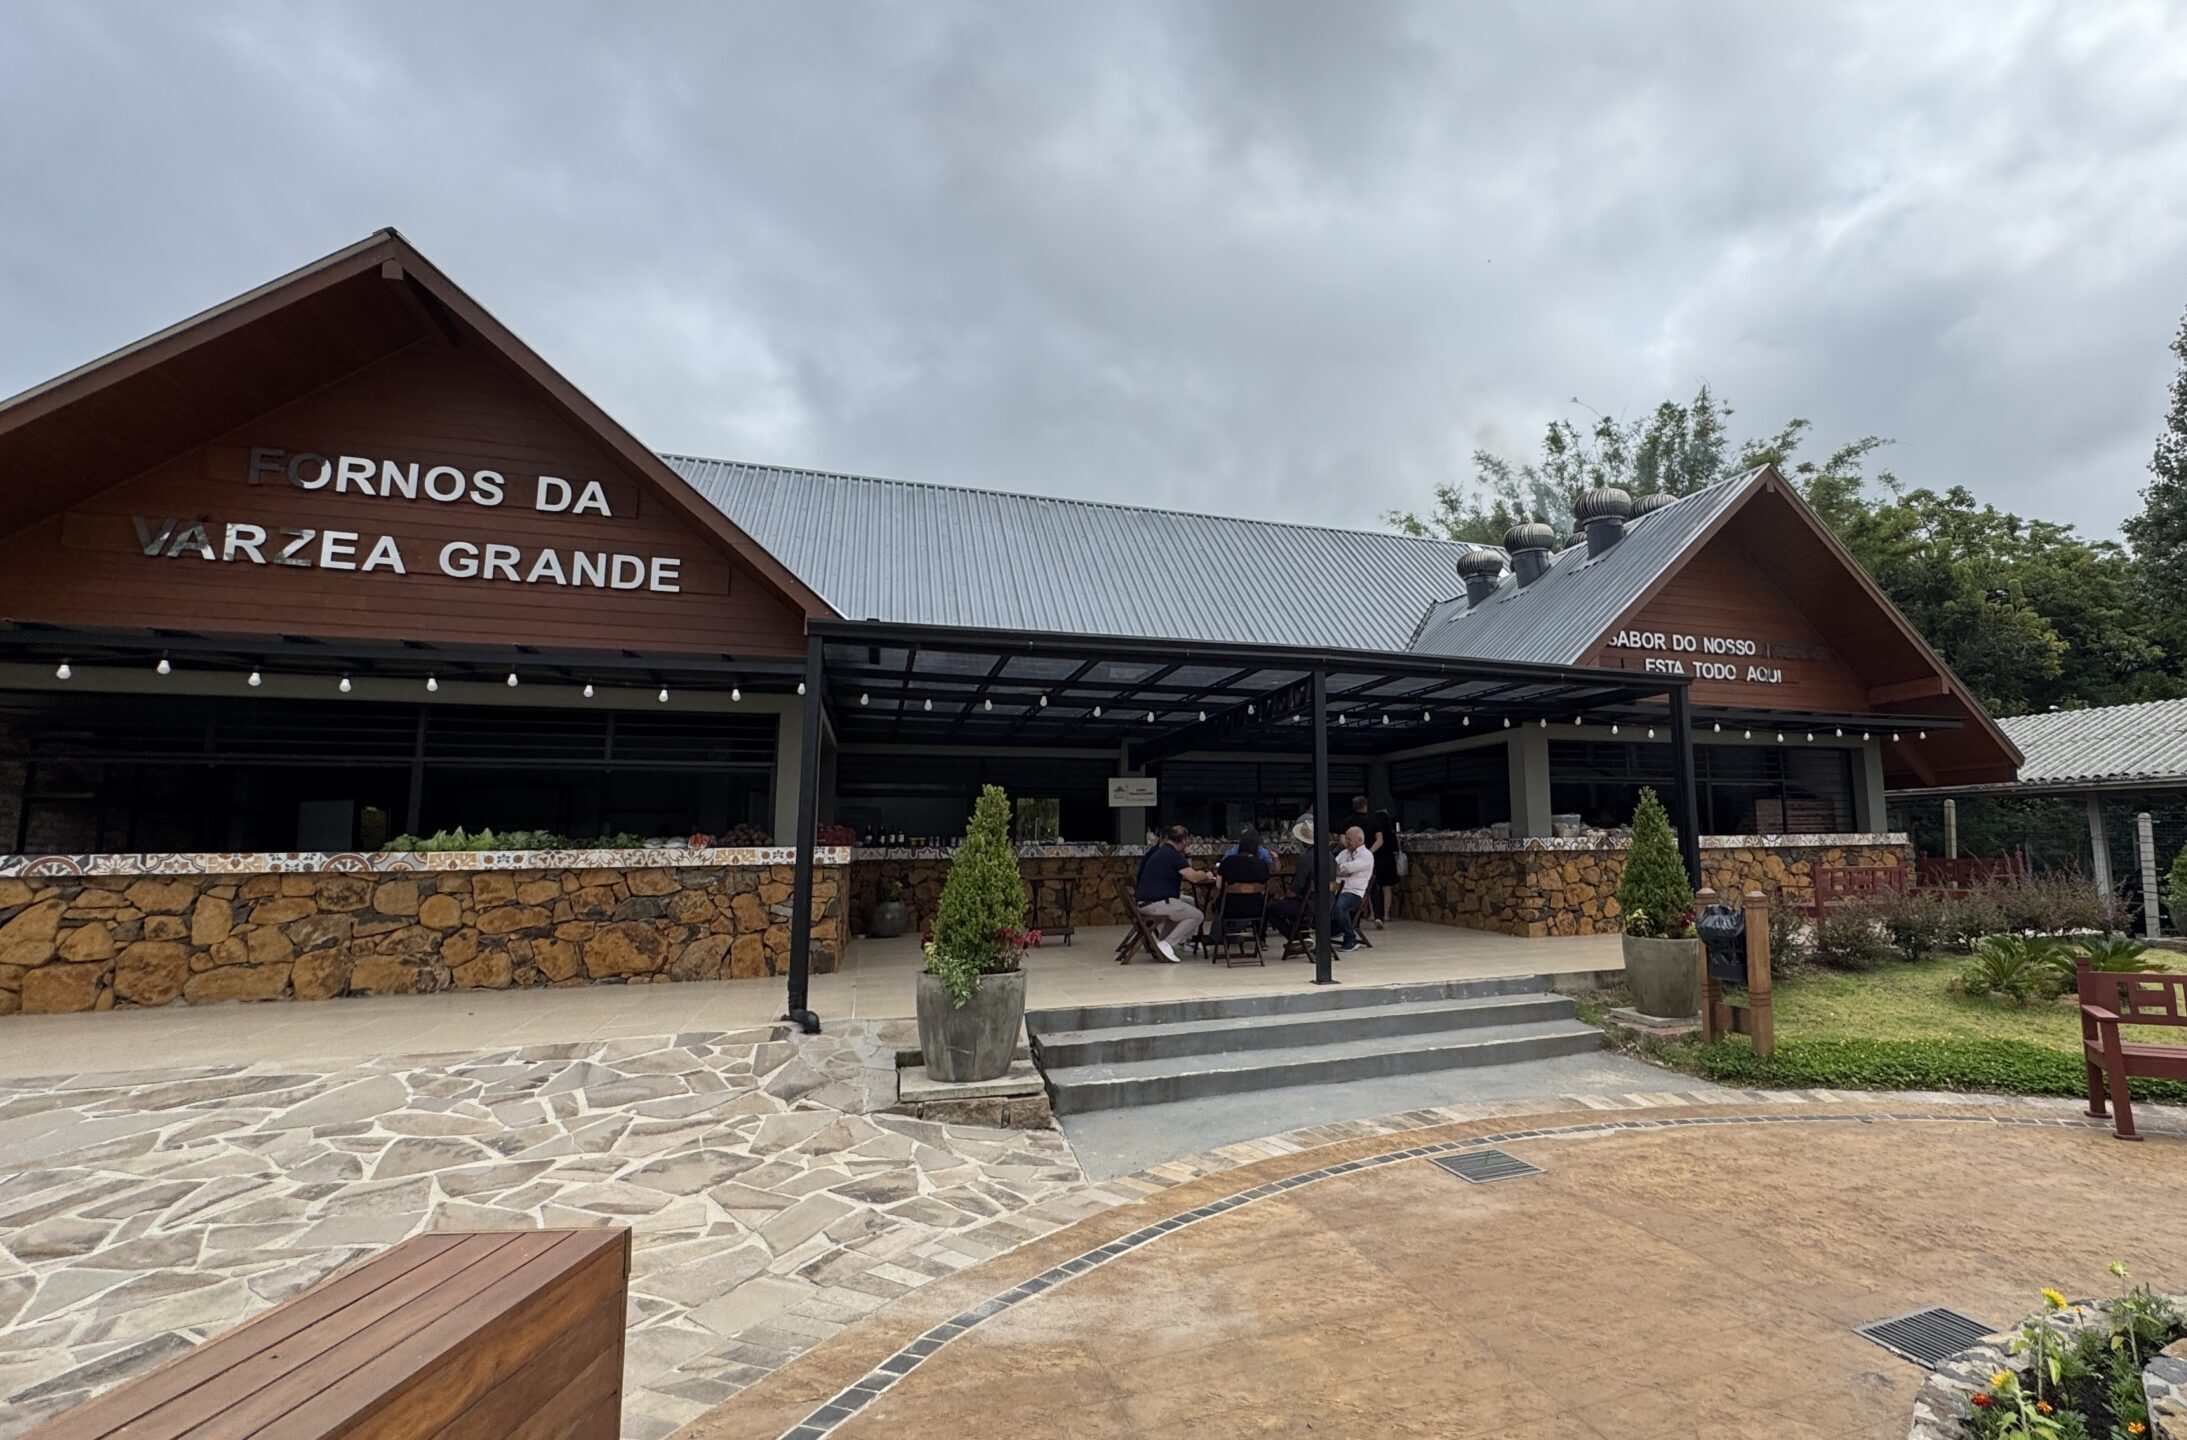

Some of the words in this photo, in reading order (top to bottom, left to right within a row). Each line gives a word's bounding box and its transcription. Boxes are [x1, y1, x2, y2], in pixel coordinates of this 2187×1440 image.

[248, 446, 505, 506] FORNOS
[535, 476, 613, 517] DA
[439, 541, 681, 593] GRANDE
[1672, 634, 1697, 652] DO
[1703, 637, 1756, 656] NOSSO
[1692, 661, 1737, 681] TODO
[1746, 665, 1783, 684] AQUI
